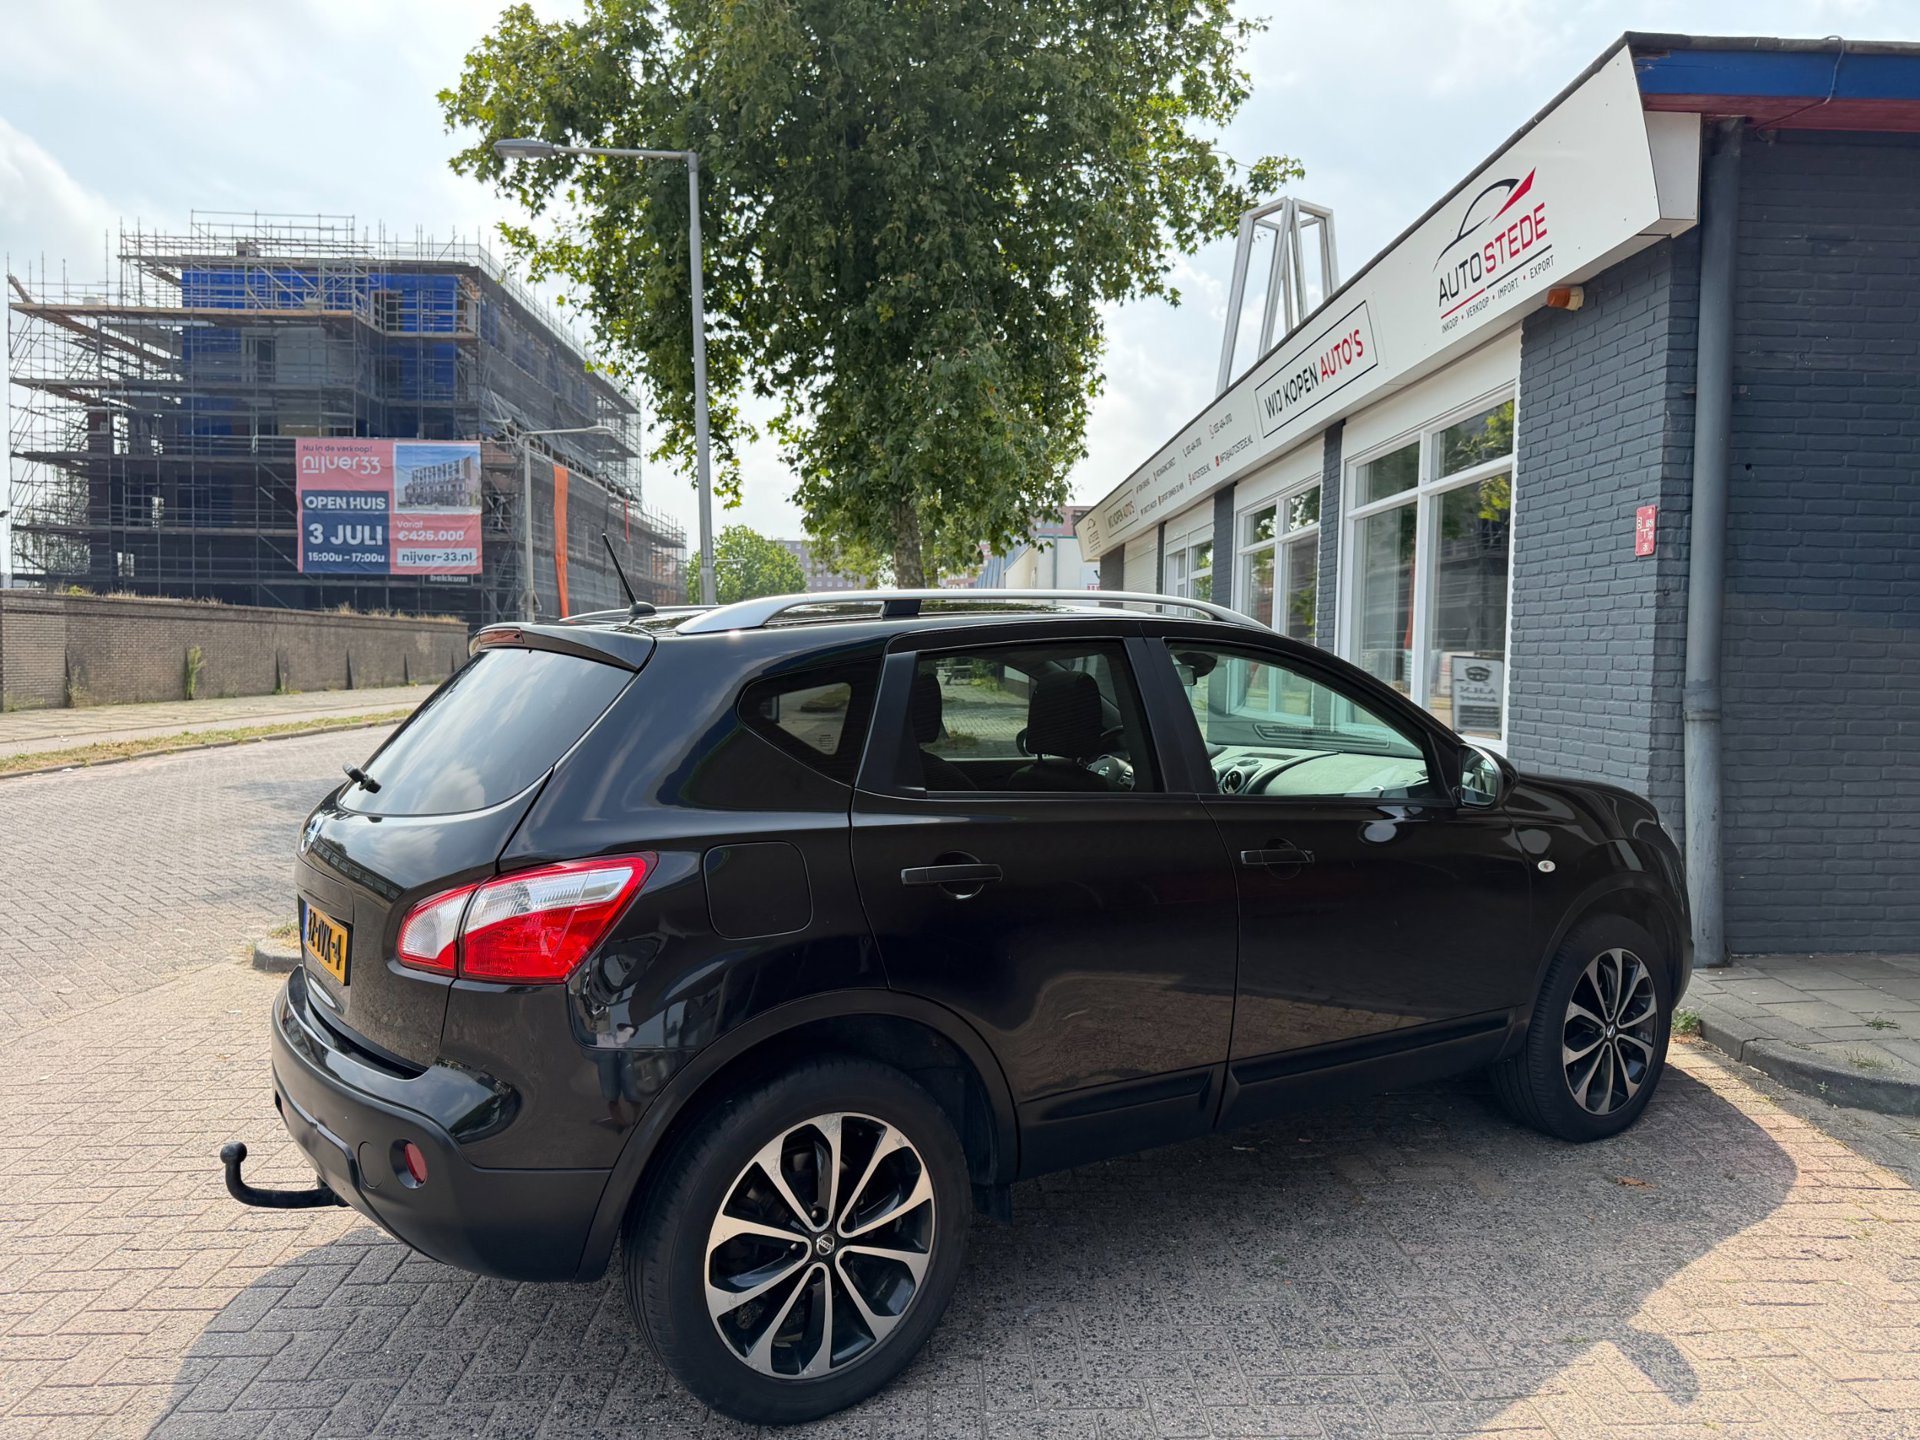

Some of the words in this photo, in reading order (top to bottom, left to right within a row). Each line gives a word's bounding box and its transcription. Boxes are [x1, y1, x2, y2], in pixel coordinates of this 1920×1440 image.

[1438, 202, 1548, 307] AUTOSTEDE
[1441, 315, 1459, 333] INKOOP
[1466, 296, 1490, 319] VERKOOP
[1497, 277, 1519, 300] IMPORT
[1529, 254, 1555, 279] EXPORT
[1263, 390, 1283, 420] WIJ
[1282, 362, 1319, 404] KOPEN
[1319, 328, 1364, 383] AUTO'S
[337, 446, 373, 454] verkoop!
[305, 496, 347, 509] OPEN
[350, 497, 386, 510] HUIS
[308, 523, 324, 545] 3
[329, 524, 383, 546] JULI
[308, 552, 342, 562] 15:00u
[352, 552, 385, 563] 17:00u
[402, 551, 473, 564] nijver-33.nl
